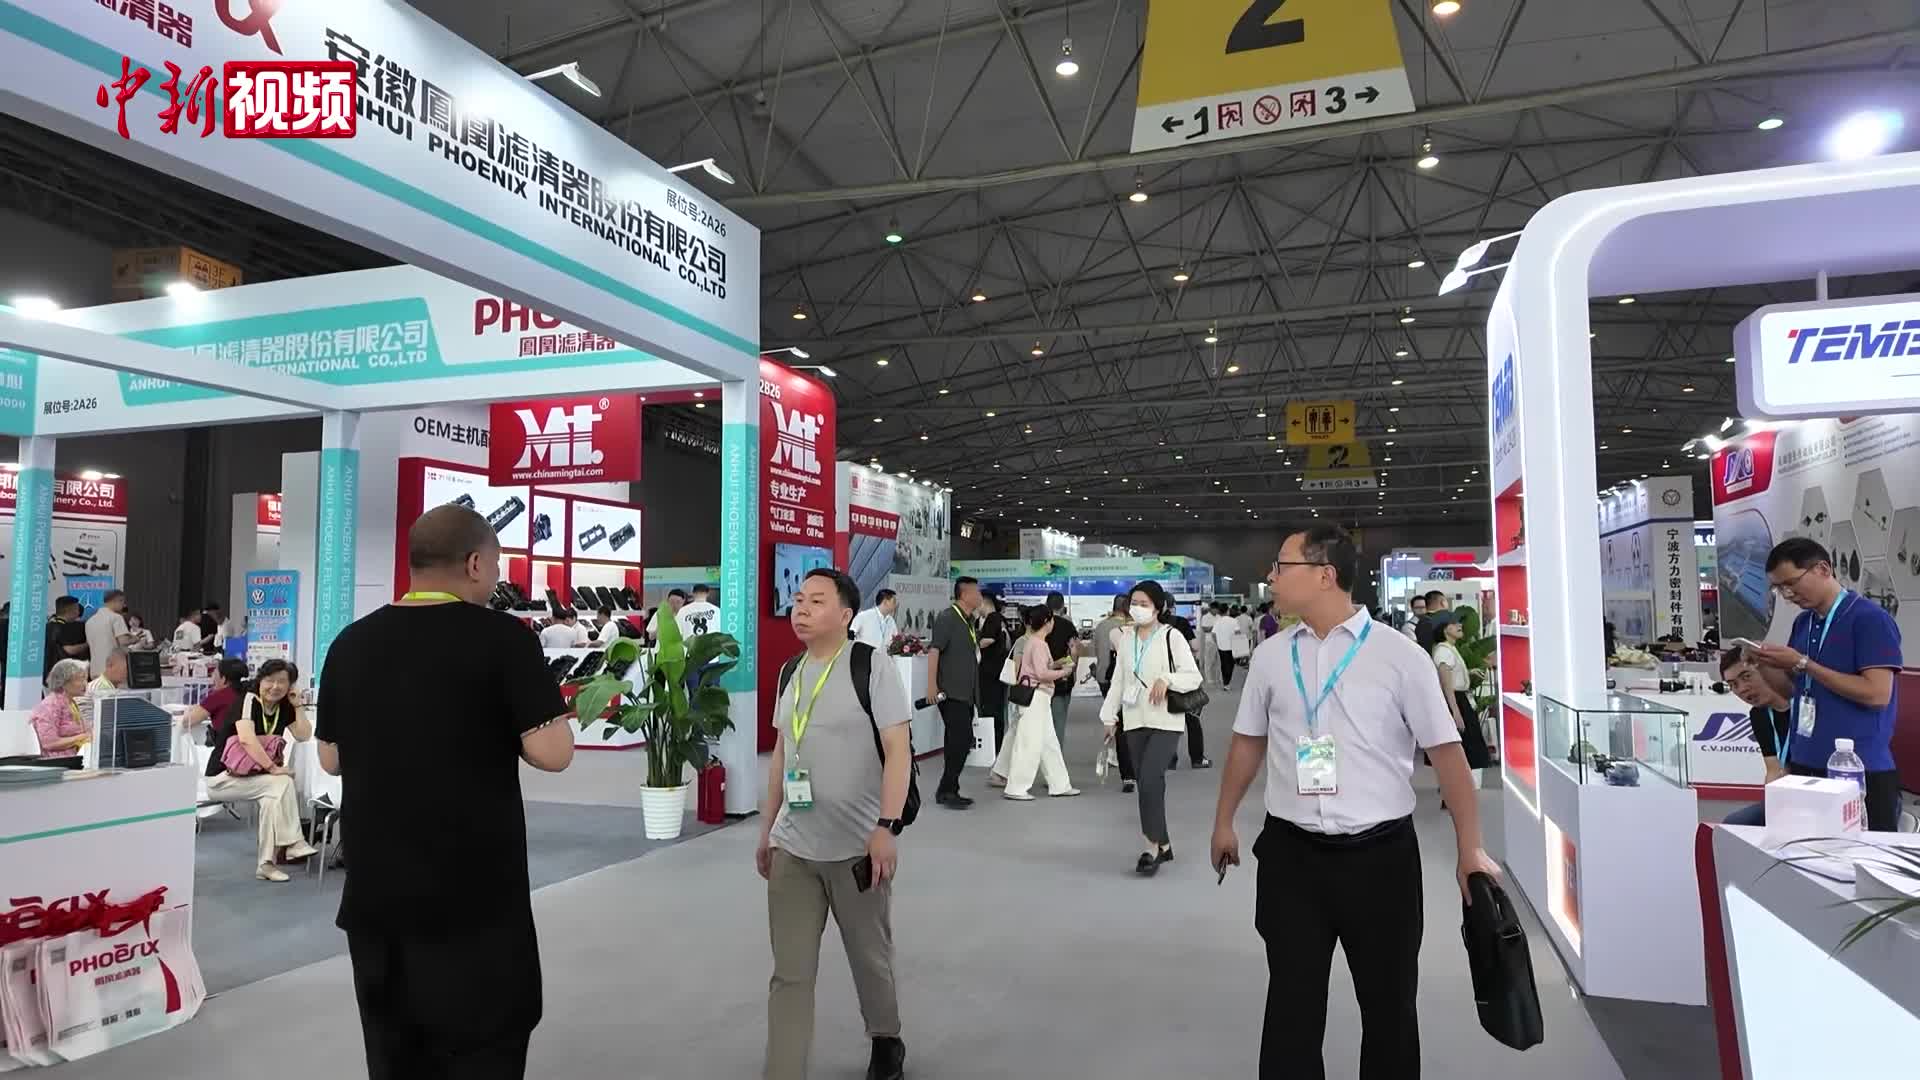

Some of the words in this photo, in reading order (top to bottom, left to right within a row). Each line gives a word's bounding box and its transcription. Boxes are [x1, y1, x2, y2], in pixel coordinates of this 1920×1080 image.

[1325, 86, 1348, 115] 3
[428, 132, 527, 200] PHOENIX
[539, 189, 671, 272] INTERNATIONAL
[678, 264, 727, 300] CO.,LTD
[666, 188, 727, 238] 展位号:2A26
[43, 397, 97, 415] 展位号:2A26
[1328, 445, 1350, 469] 2
[512, 467, 604, 481] www.chinamingtai.com
[769, 480, 807, 503] 专业生产
[727, 492, 739, 553] PHOENIX
[727, 559, 738, 607] FILTER
[1428, 570, 1453, 580] GNS
